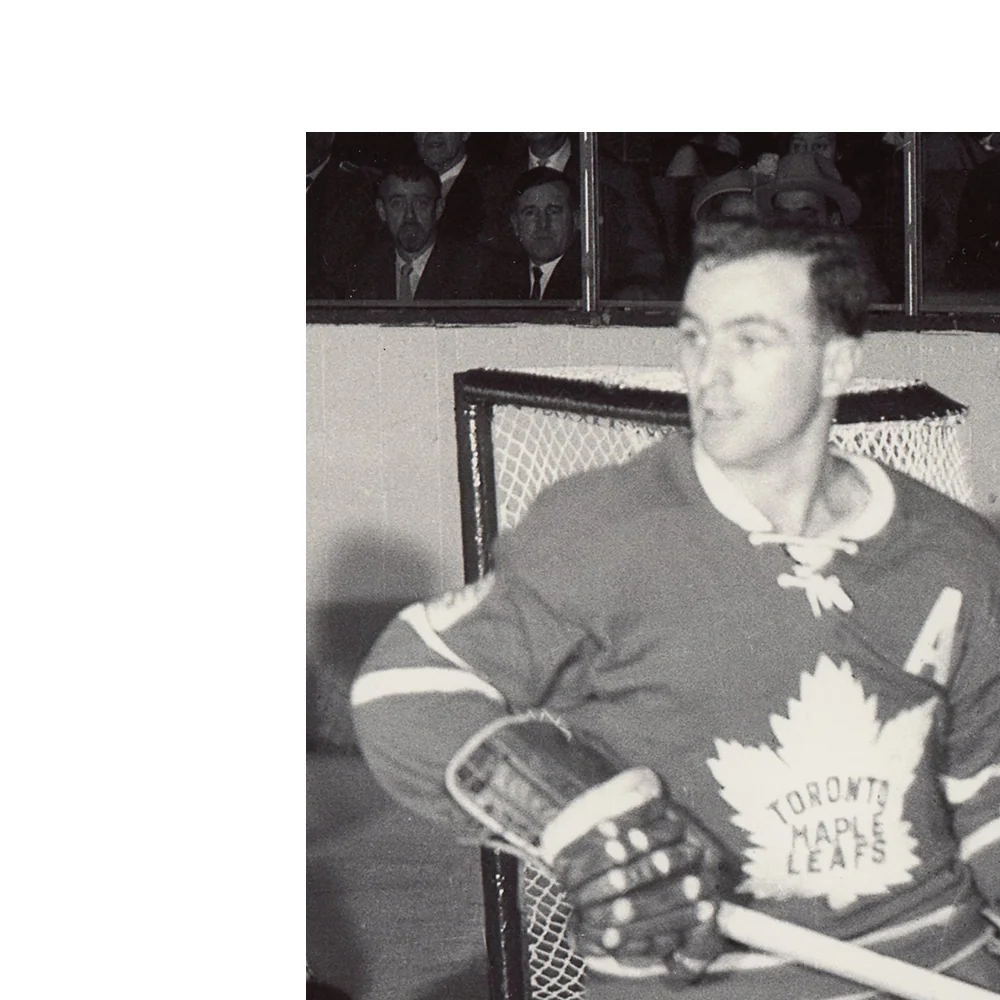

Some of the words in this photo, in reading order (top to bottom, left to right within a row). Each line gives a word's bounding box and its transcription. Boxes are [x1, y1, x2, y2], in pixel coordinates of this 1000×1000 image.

[904, 586, 963, 686] A
[767, 776, 890, 824] TORONTO
[791, 812, 886, 847] MAPLE
[787, 839, 887, 875] LEAFS
